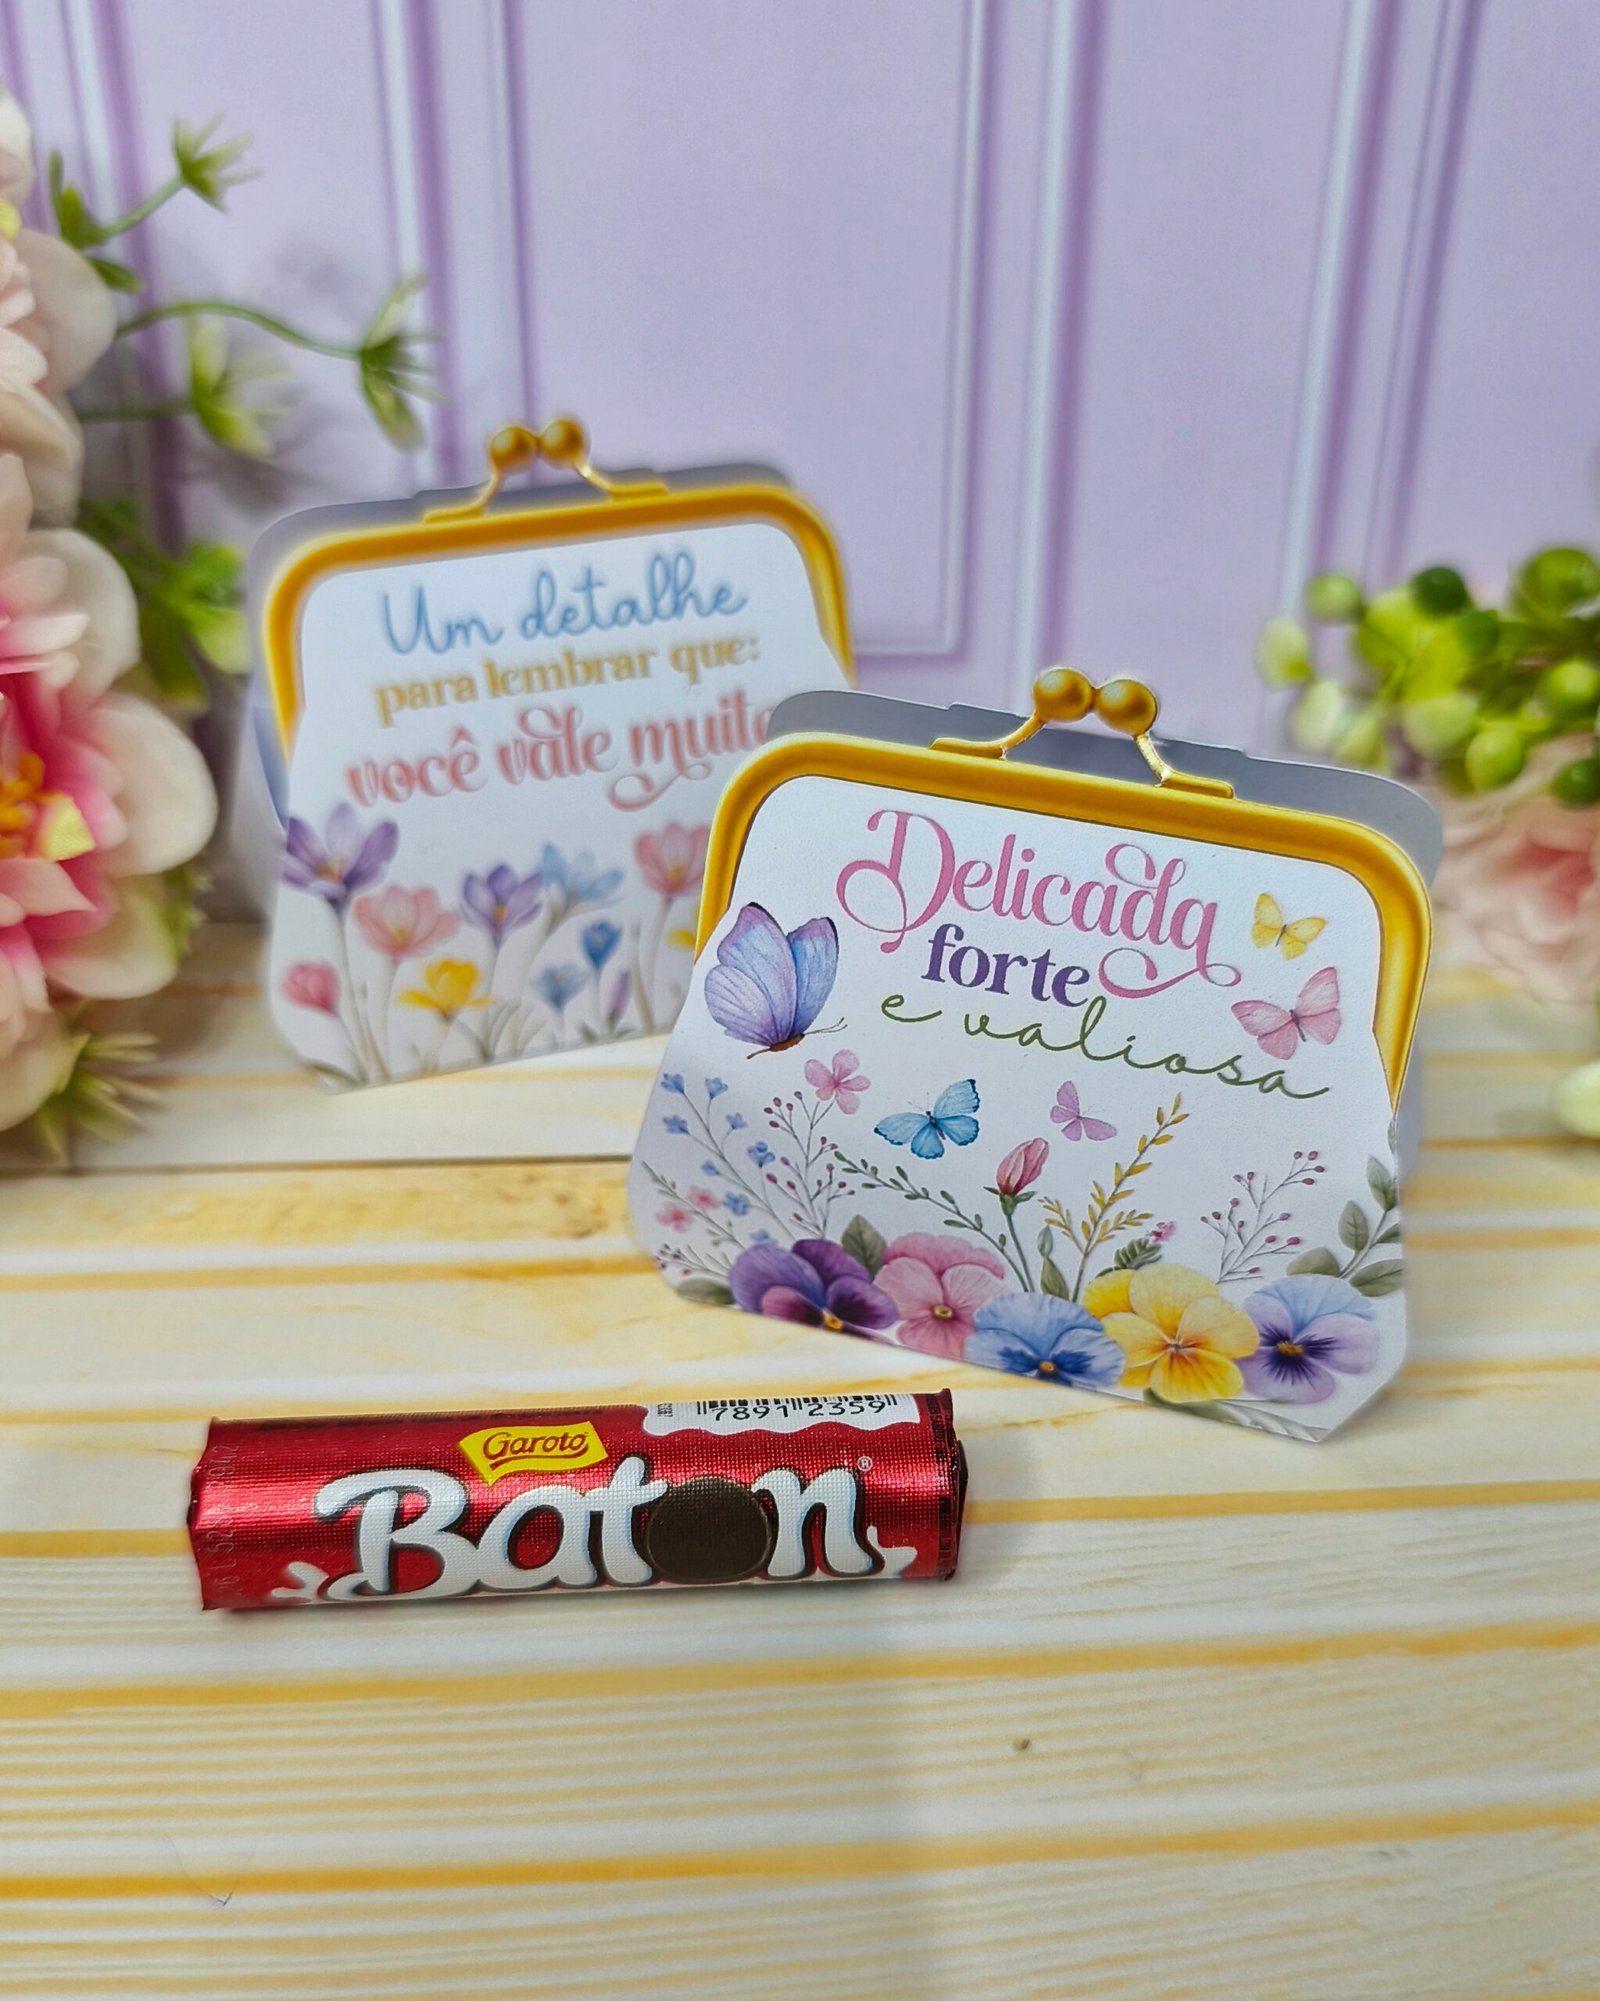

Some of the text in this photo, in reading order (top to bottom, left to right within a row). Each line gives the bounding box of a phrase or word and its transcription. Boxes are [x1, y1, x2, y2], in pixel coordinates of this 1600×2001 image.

[380, 547, 748, 656] Um detalhe
[374, 634, 760, 728] para lembrar que:
[345, 724, 486, 807] você
[497, 705, 617, 785] vale
[836, 809, 1242, 999] Delicada
[921, 922, 1091, 1007] forte
[881, 994, 1330, 1100] e valiosa
[482, 1431, 588, 1461] Garoto
[712, 1401, 886, 1422] 7891 2359
[314, 1454, 890, 1601] Baton
